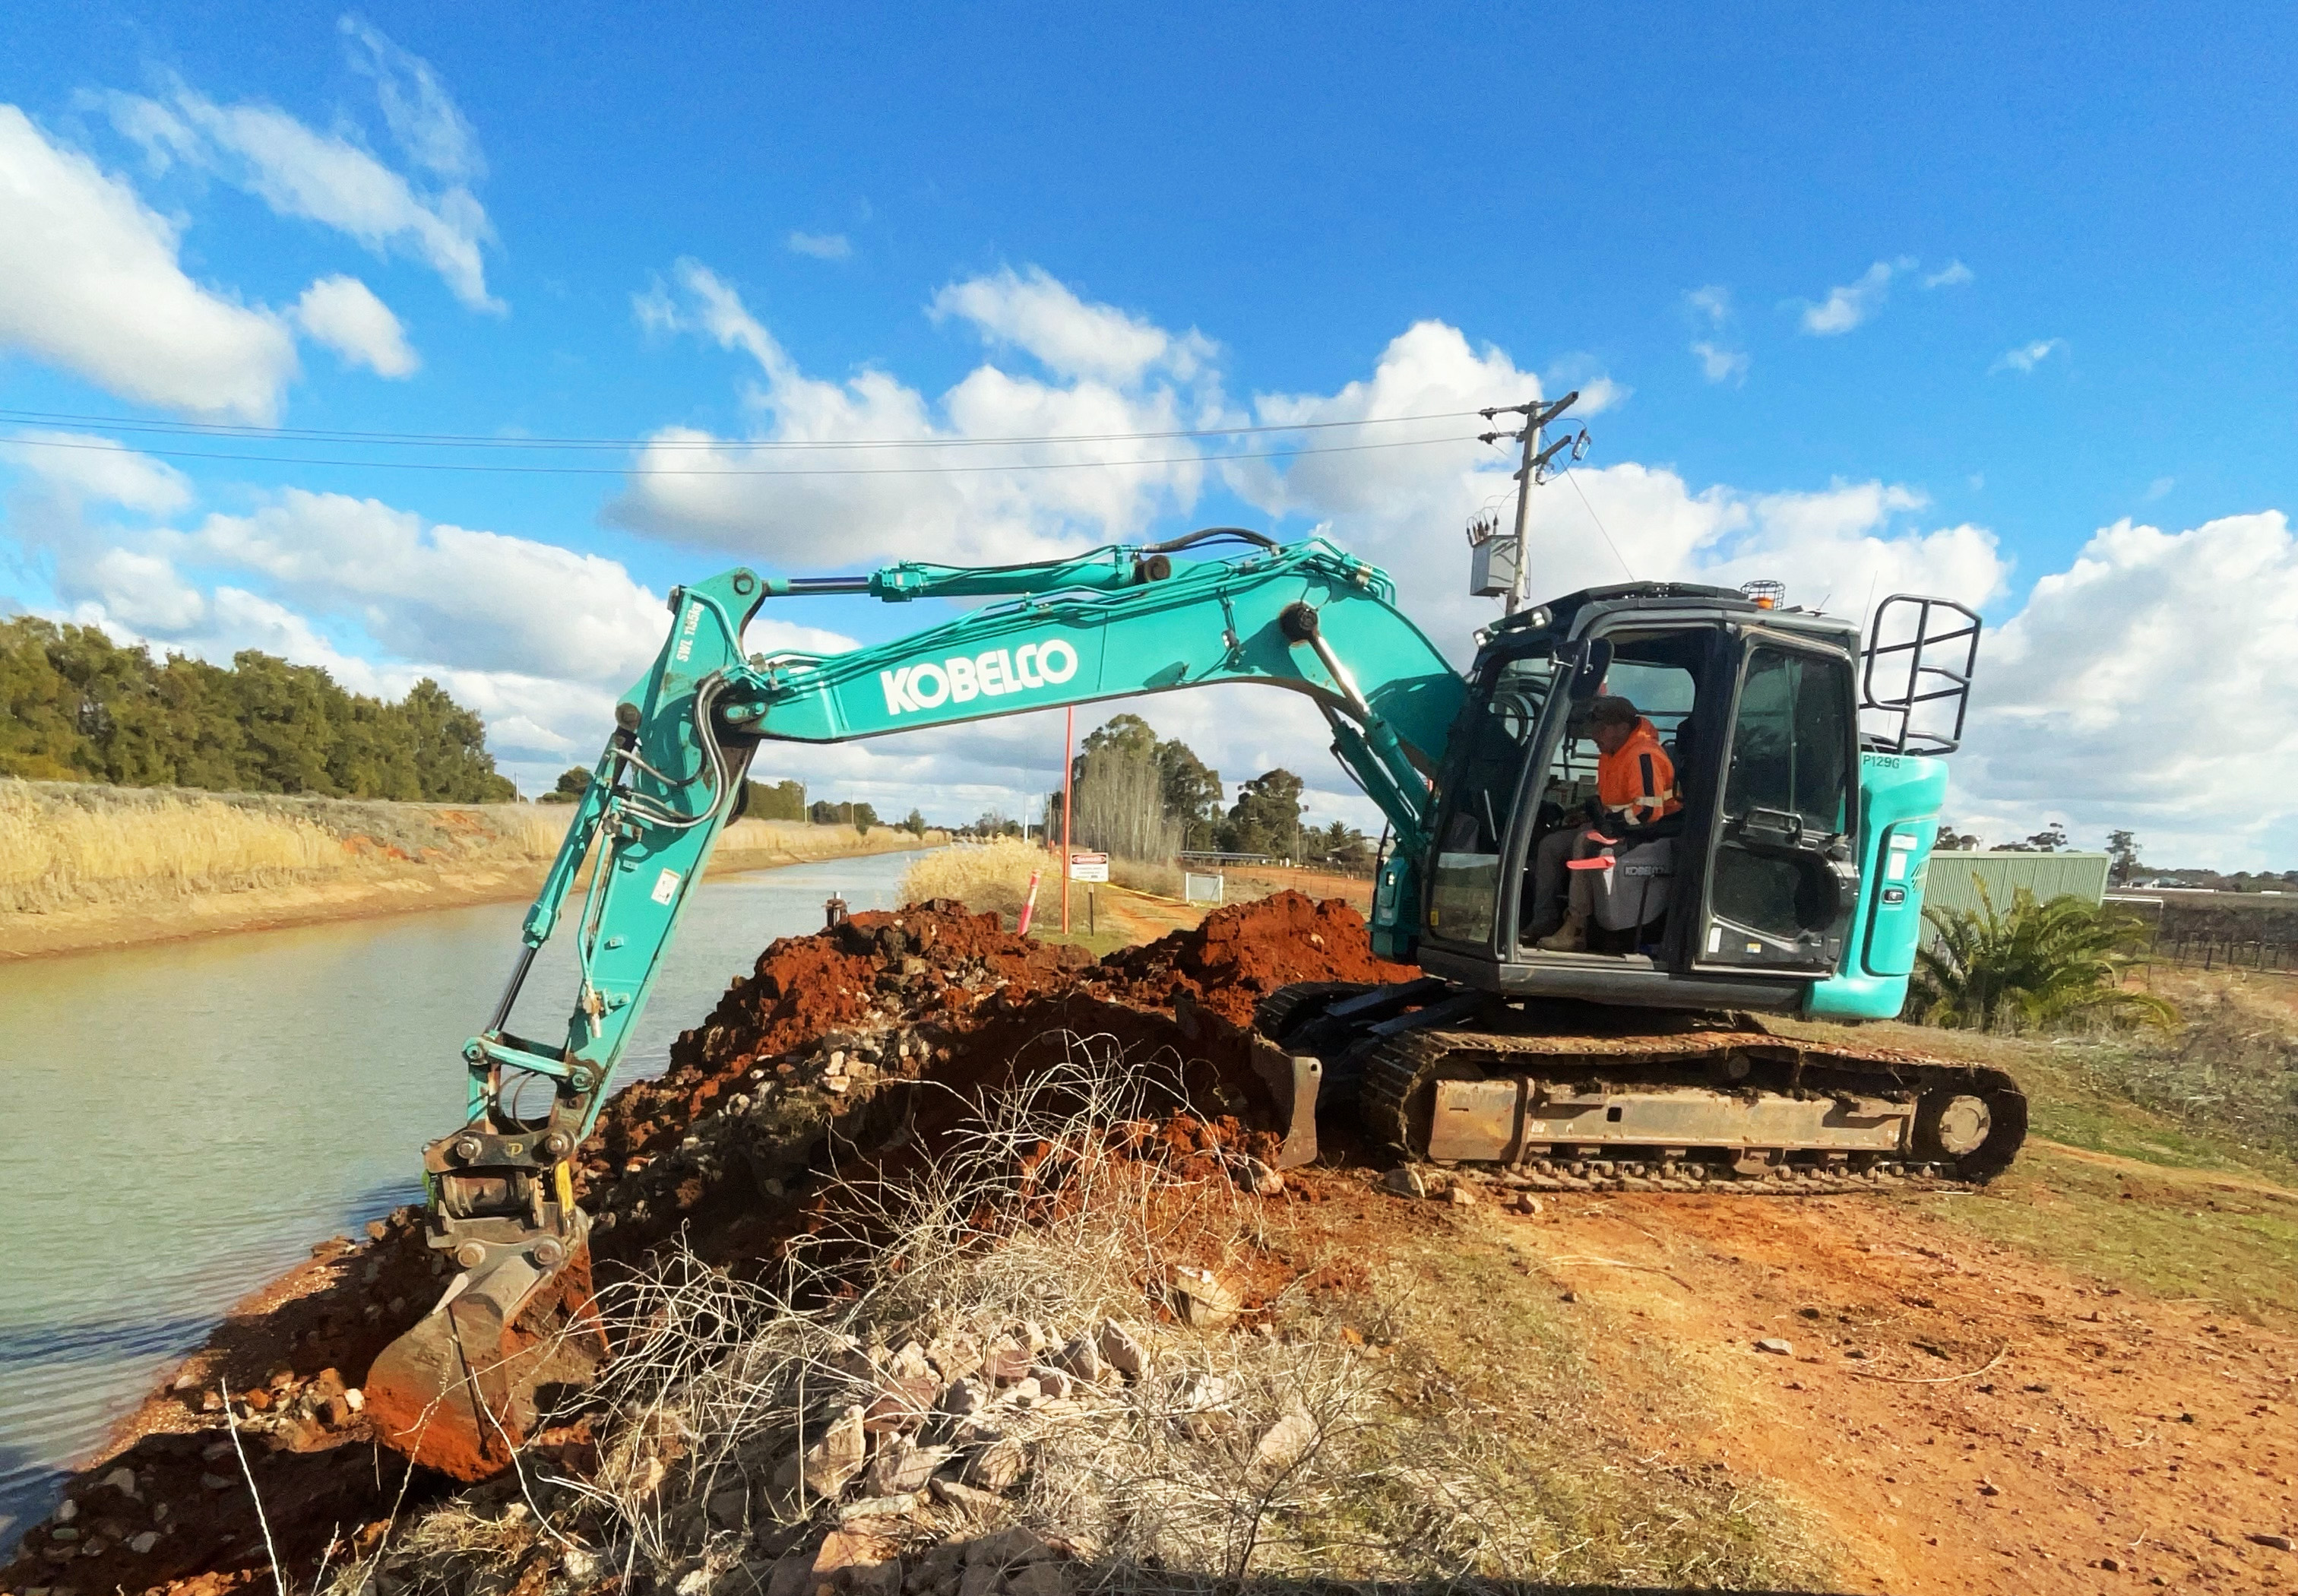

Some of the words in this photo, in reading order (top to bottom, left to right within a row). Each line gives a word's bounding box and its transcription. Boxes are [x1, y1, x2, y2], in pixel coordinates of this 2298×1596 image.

[676, 638, 693, 662] SWL
[880, 639, 1078, 716] KOBELCO
[1863, 755, 1900, 769] P129G
